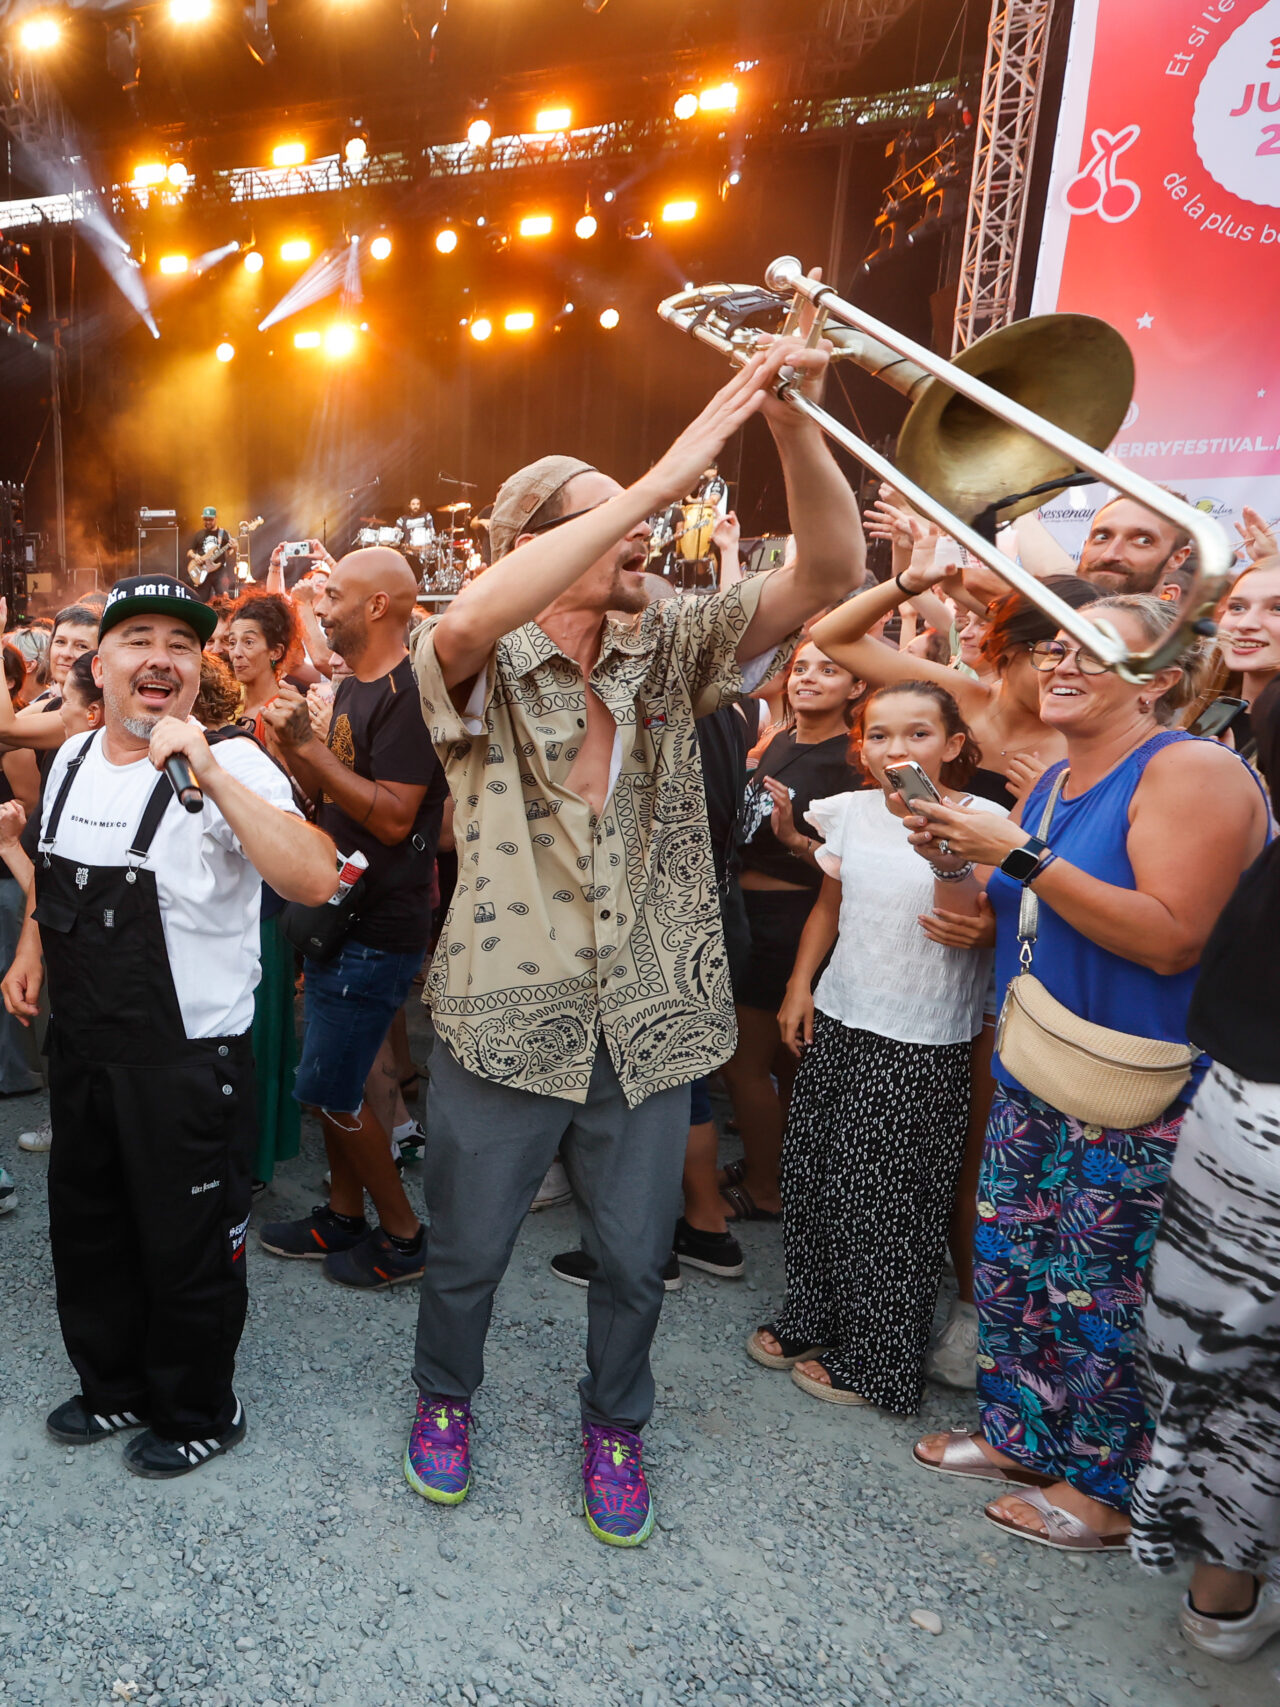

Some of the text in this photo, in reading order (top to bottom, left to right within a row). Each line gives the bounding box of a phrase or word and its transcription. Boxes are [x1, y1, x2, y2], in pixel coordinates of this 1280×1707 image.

[1165, 52, 1195, 76] Et
[1188, 25, 1210, 47] si
[1229, 81, 1280, 117] JU
[1255, 123, 1280, 156] 2
[1163, 172, 1188, 200] de
[1183, 193, 1205, 219] la
[1200, 212, 1255, 241] plus
[1109, 436, 1280, 458] ERRYFESTIVAL.
[71, 815, 89, 825] BORN
